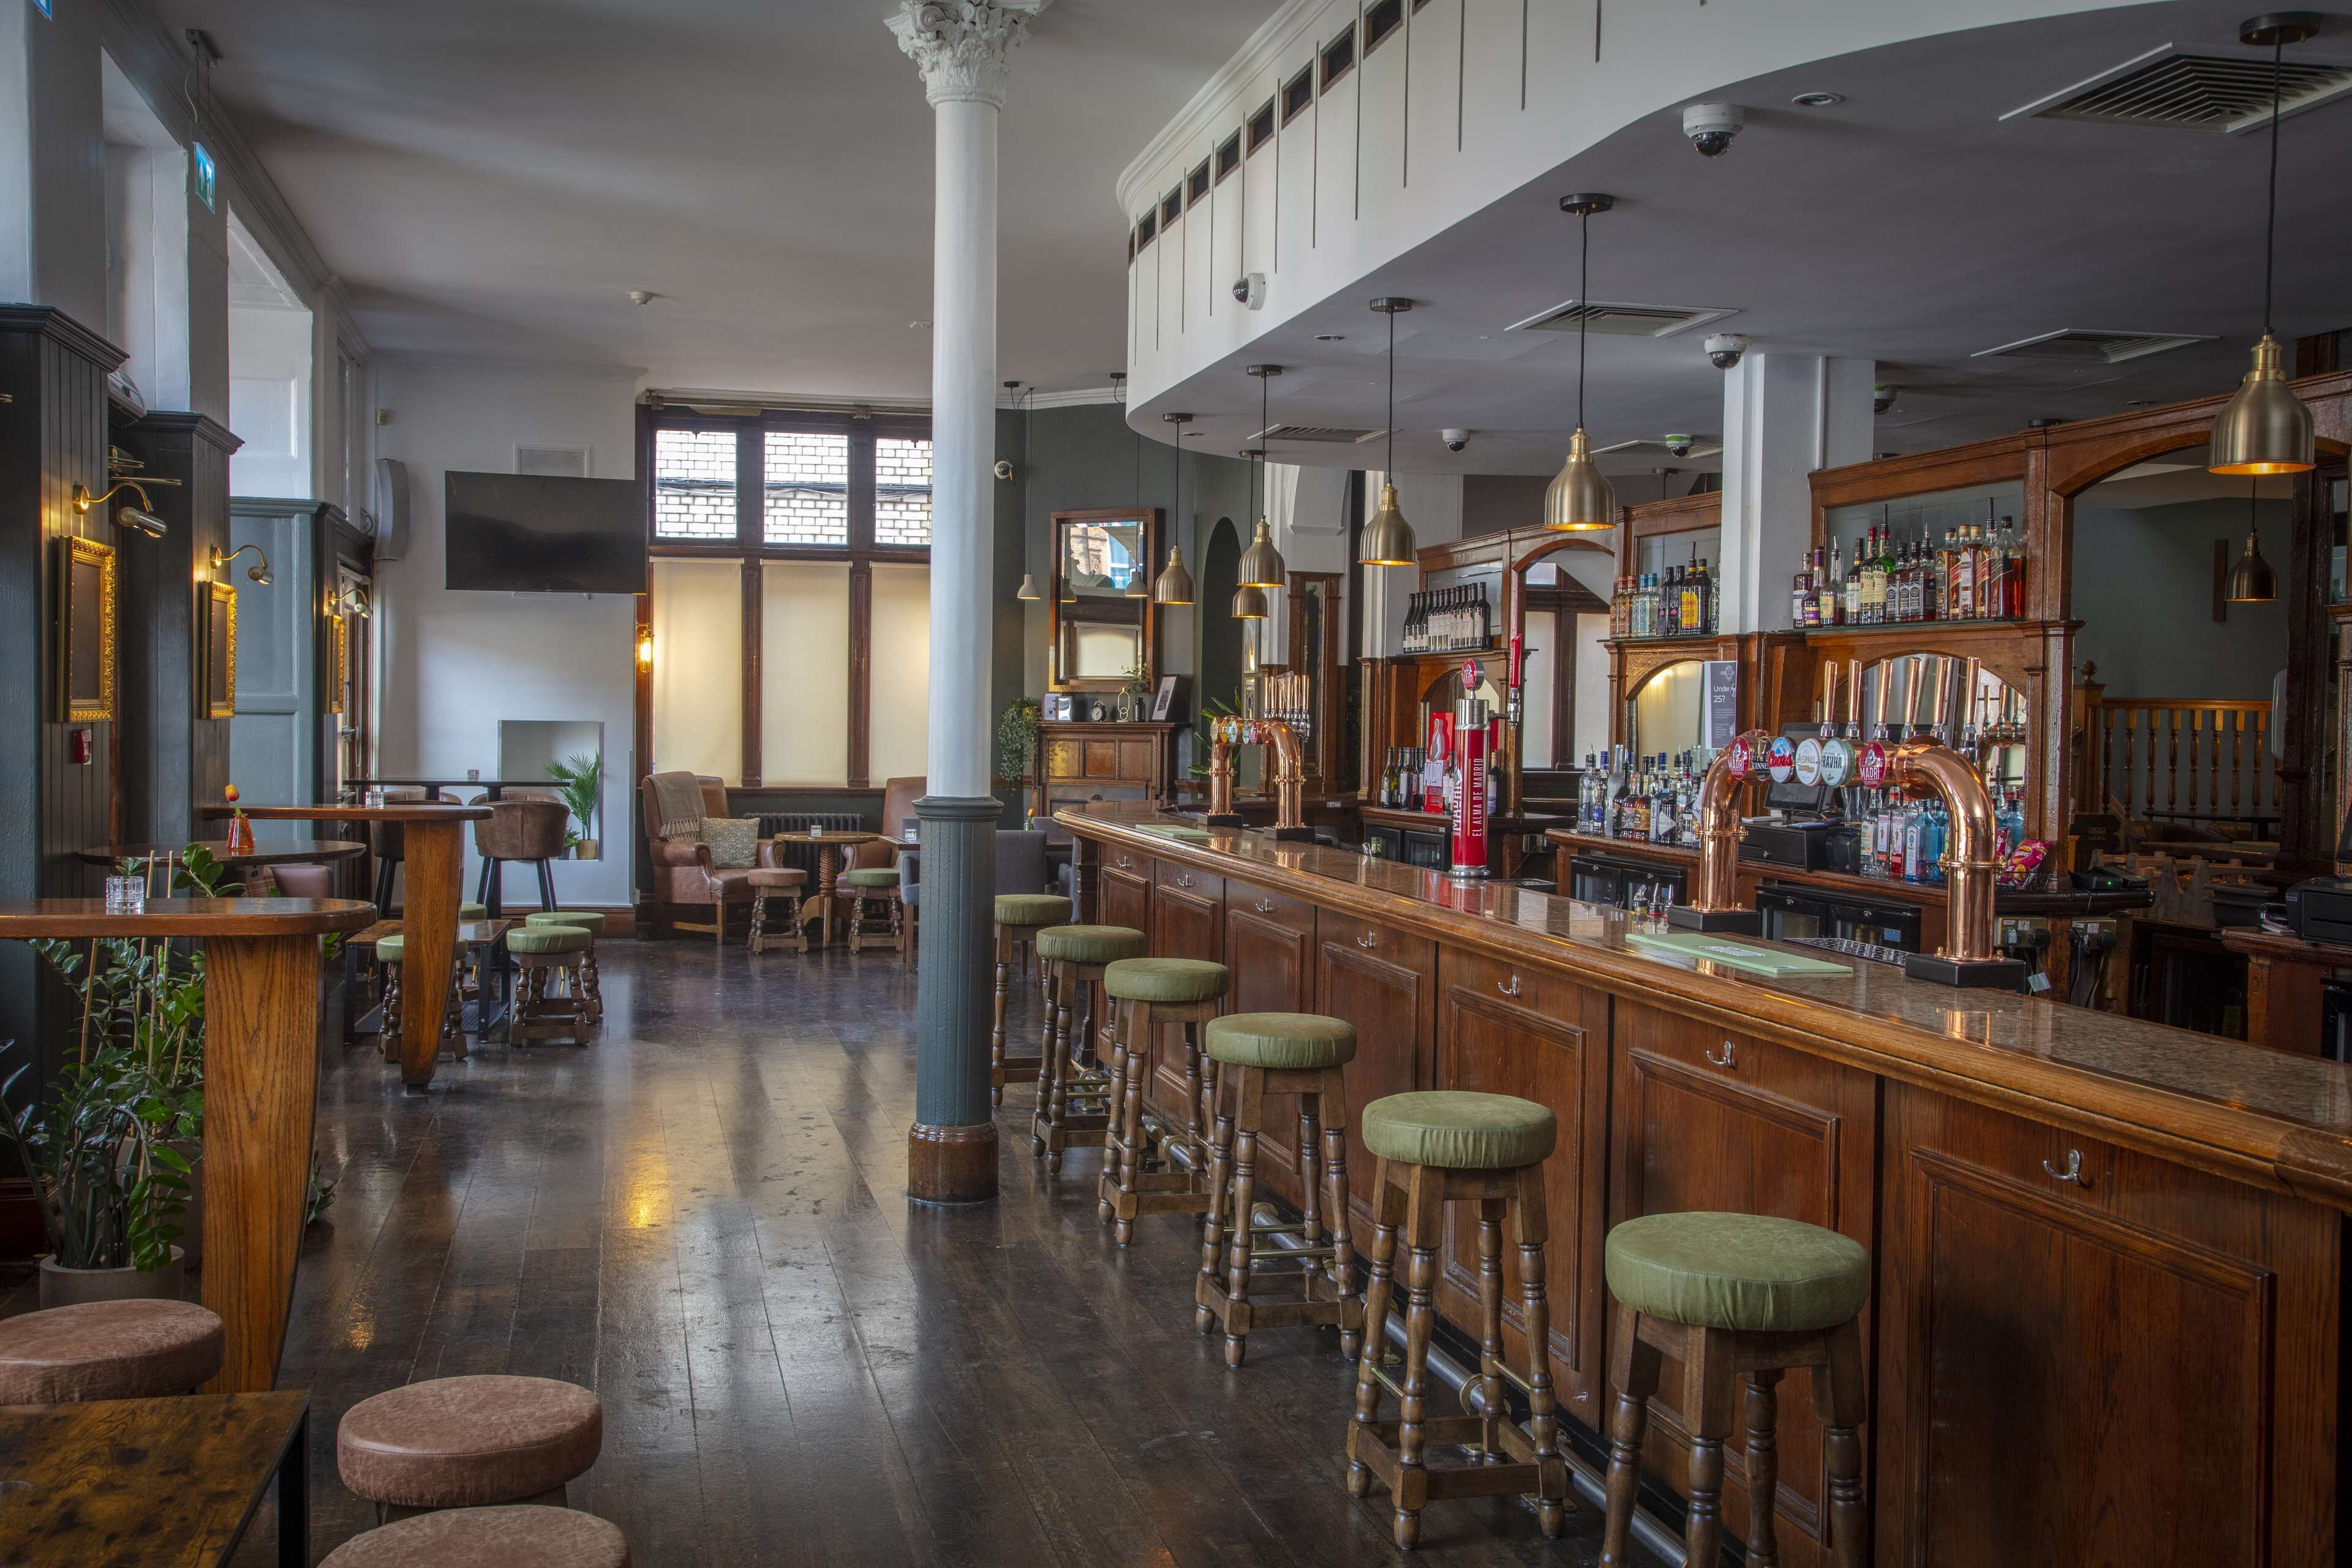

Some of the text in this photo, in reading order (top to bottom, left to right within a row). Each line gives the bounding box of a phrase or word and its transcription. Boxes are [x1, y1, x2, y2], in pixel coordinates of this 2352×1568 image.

[1768, 750, 1792, 767] Coors
[1472, 758, 1483, 837] EL ALMA DE MADRID
